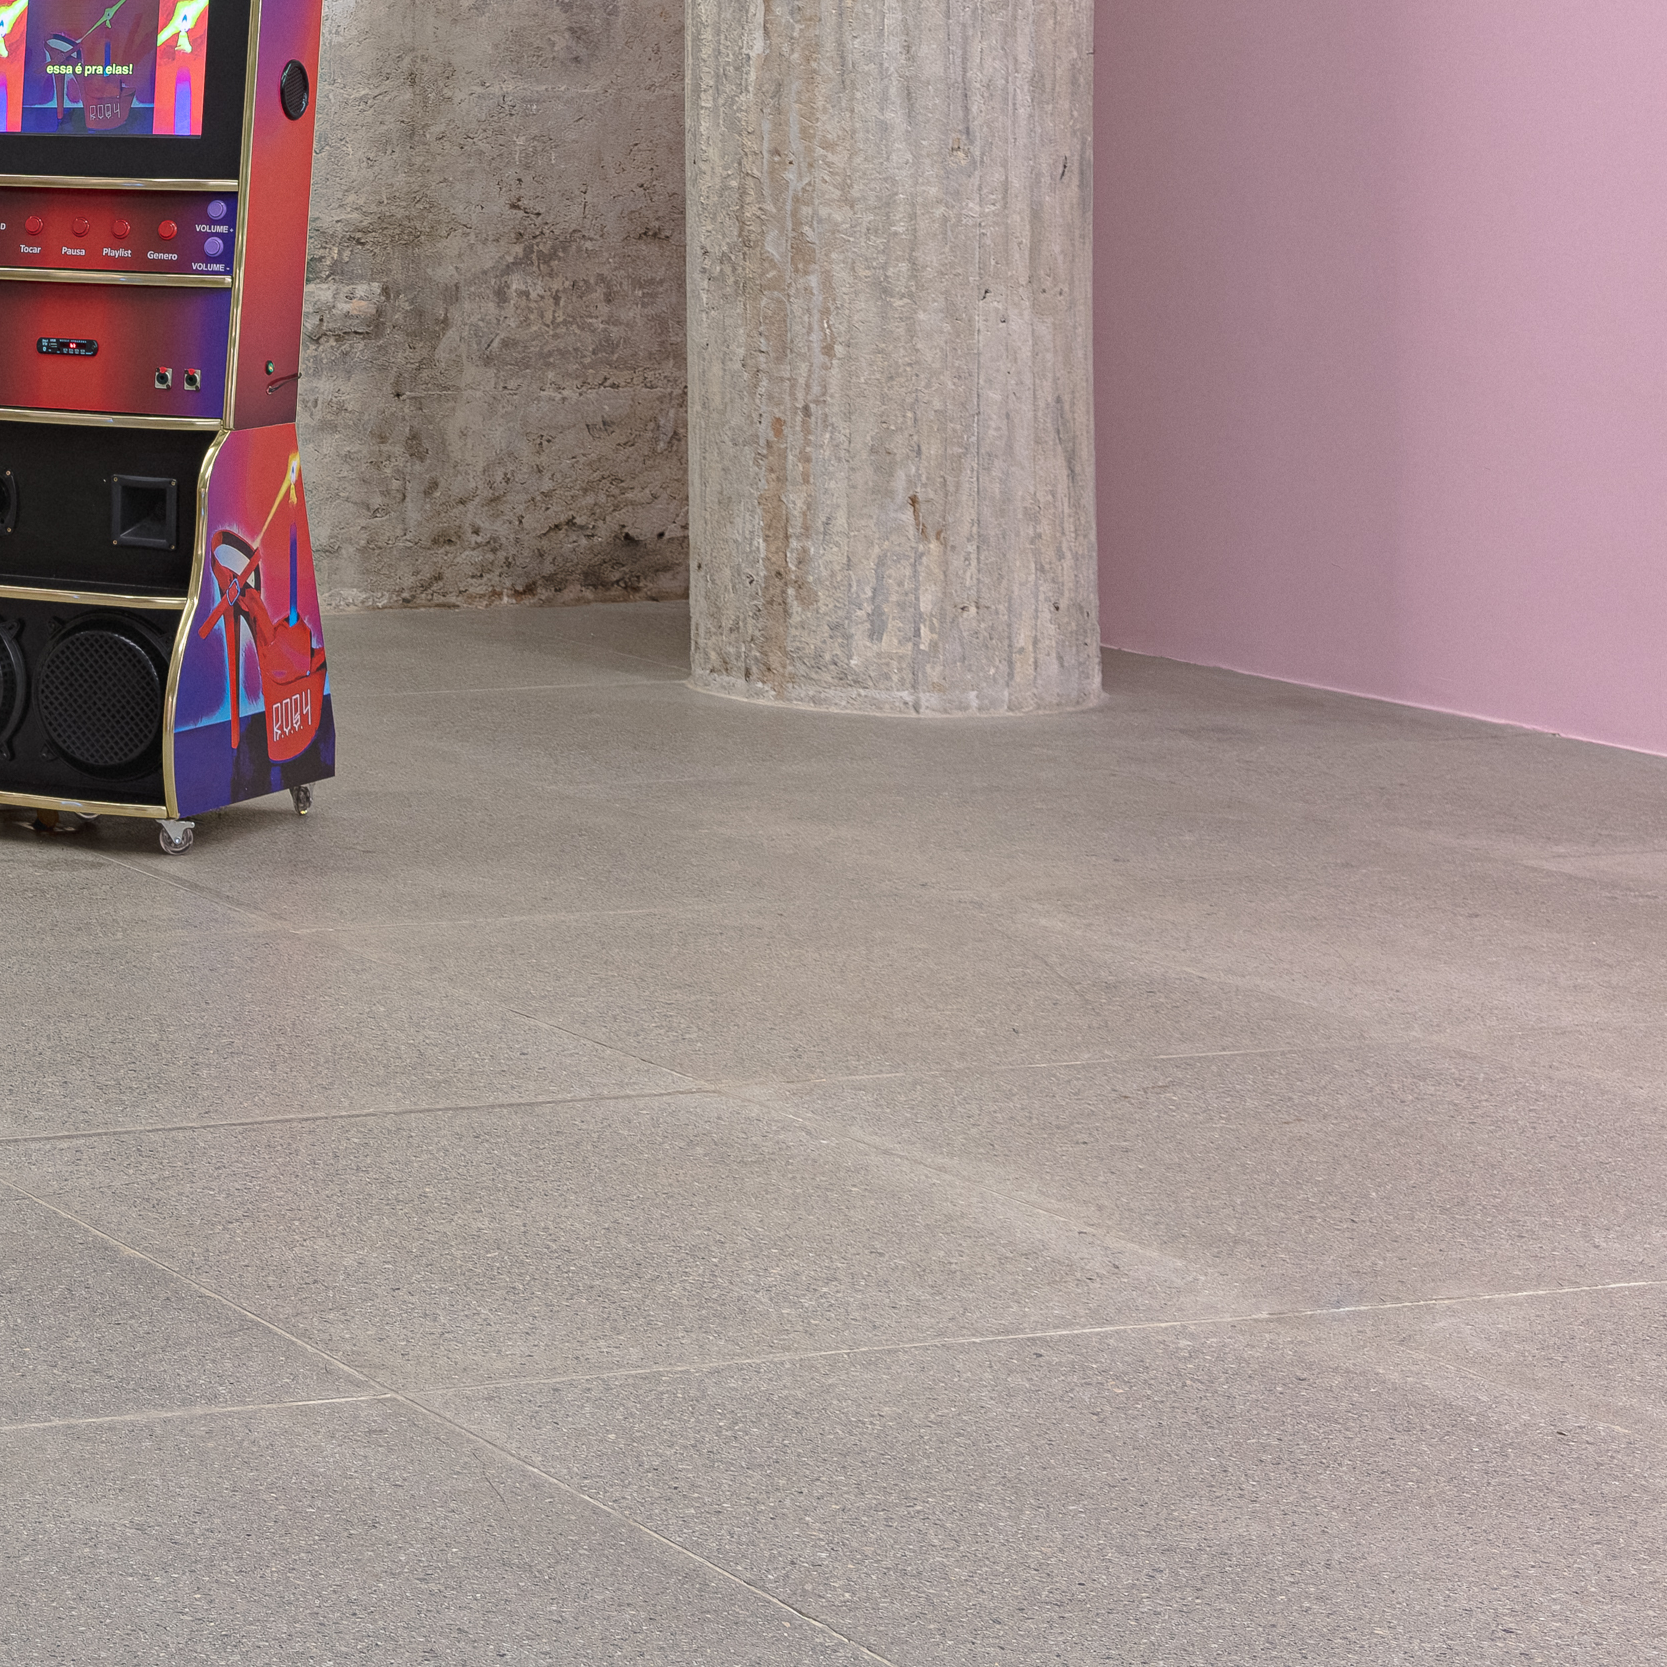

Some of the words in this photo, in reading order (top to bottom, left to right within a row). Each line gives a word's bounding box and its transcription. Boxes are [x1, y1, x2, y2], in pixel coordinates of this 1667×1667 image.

[46, 64, 73, 75] essa
[75, 62, 82, 75] é
[84, 64, 103, 77] pra
[105, 63, 134, 75] elas!
[195, 224, 229, 233] VOLUME
[19, 244, 42, 254] Tocar
[61, 246, 86, 256] Pausa
[102, 247, 132, 259] Playlist
[147, 250, 178, 261] Genero
[192, 262, 225, 272] VOLUME
